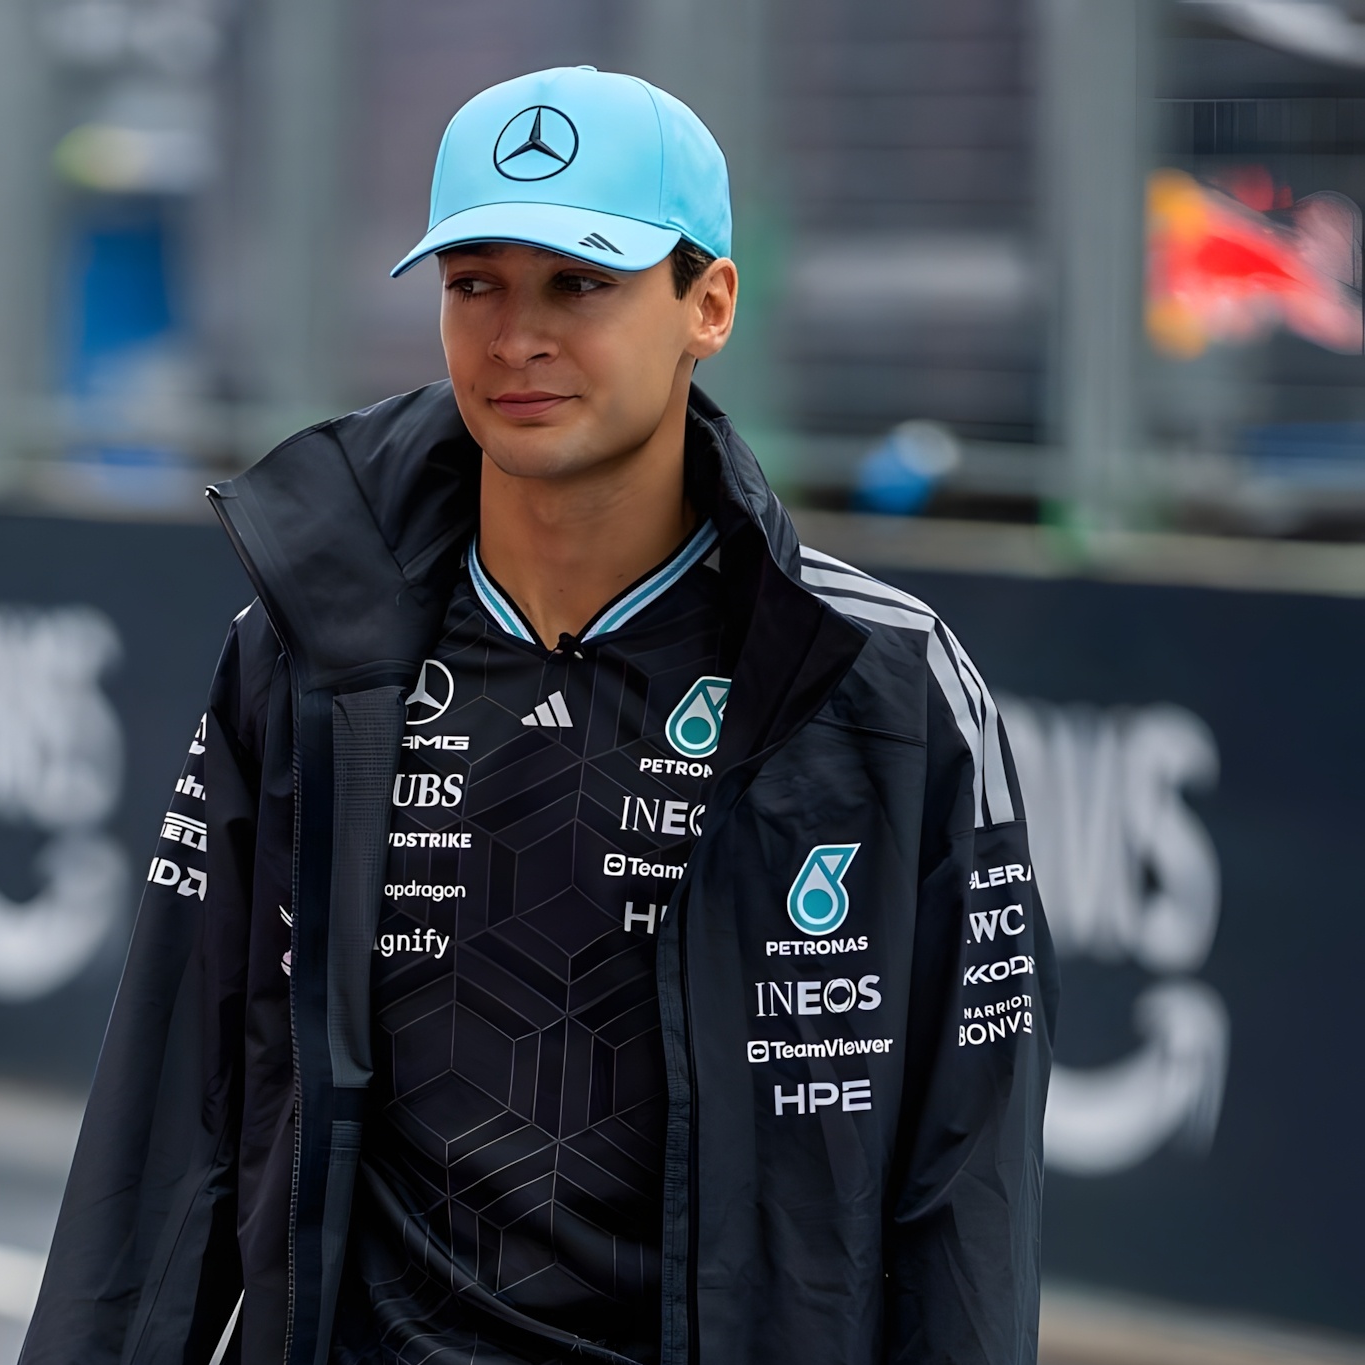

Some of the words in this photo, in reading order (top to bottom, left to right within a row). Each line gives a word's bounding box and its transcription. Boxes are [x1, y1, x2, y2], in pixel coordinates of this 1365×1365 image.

[392, 773, 464, 807] UBS
[389, 832, 473, 848] DSTRIKE
[627, 857, 688, 880] Team
[765, 935, 869, 957] PETRONAS
[754, 974, 882, 1017] INEOS
[769, 1037, 894, 1060] TeamViewer
[773, 1078, 872, 1116] HPE
